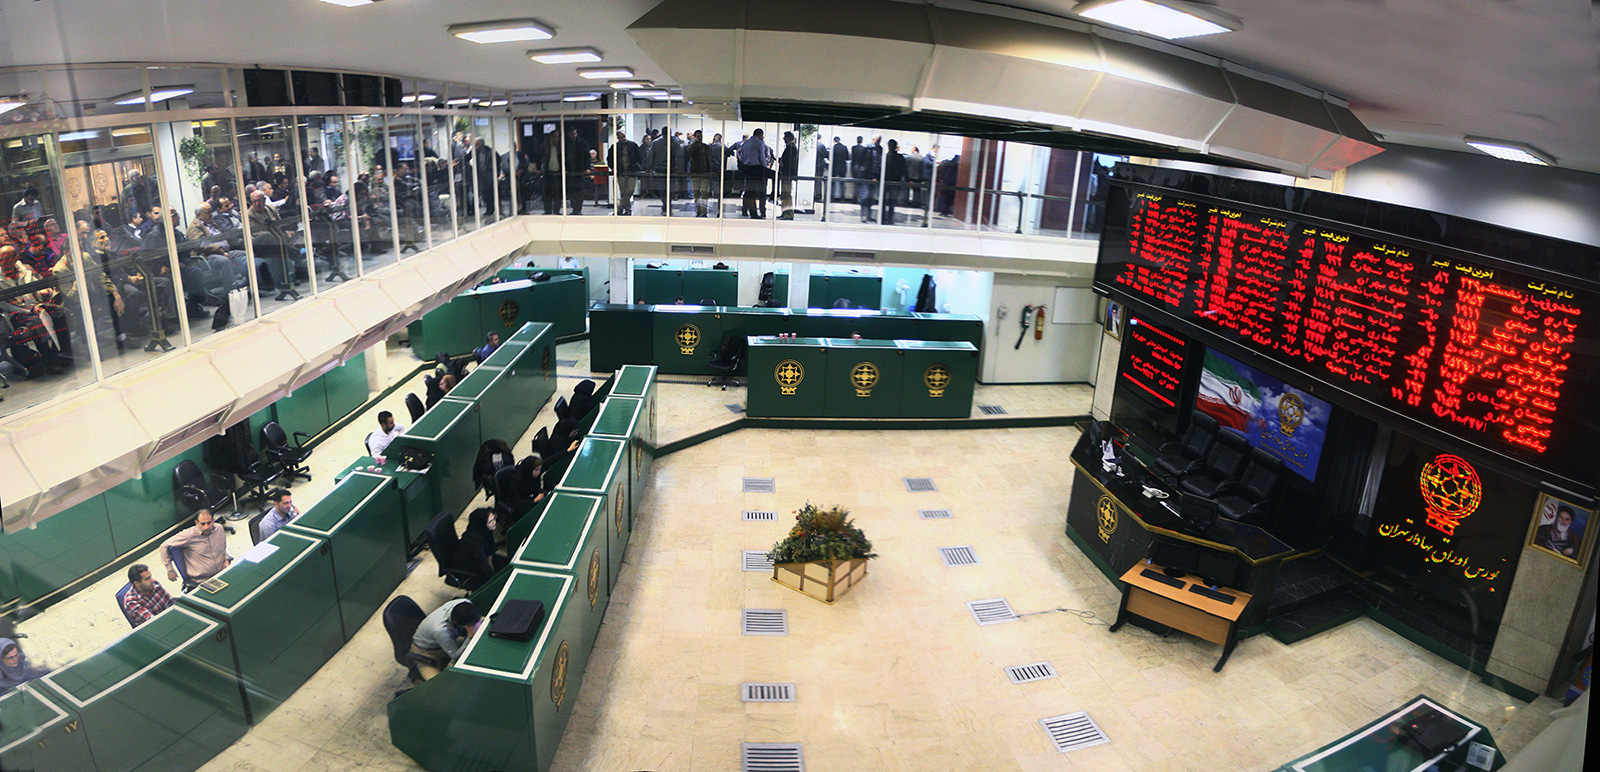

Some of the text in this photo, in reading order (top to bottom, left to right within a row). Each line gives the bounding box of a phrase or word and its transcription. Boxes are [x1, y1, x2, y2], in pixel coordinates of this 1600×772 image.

[1431, 260, 1450, 269] تغییر
[1526, 281, 1558, 296] شرکت
[1379, 518, 1410, 537] تهران
[1431, 537, 1469, 566] اوراق
[1464, 566, 1500, 592] بورس
